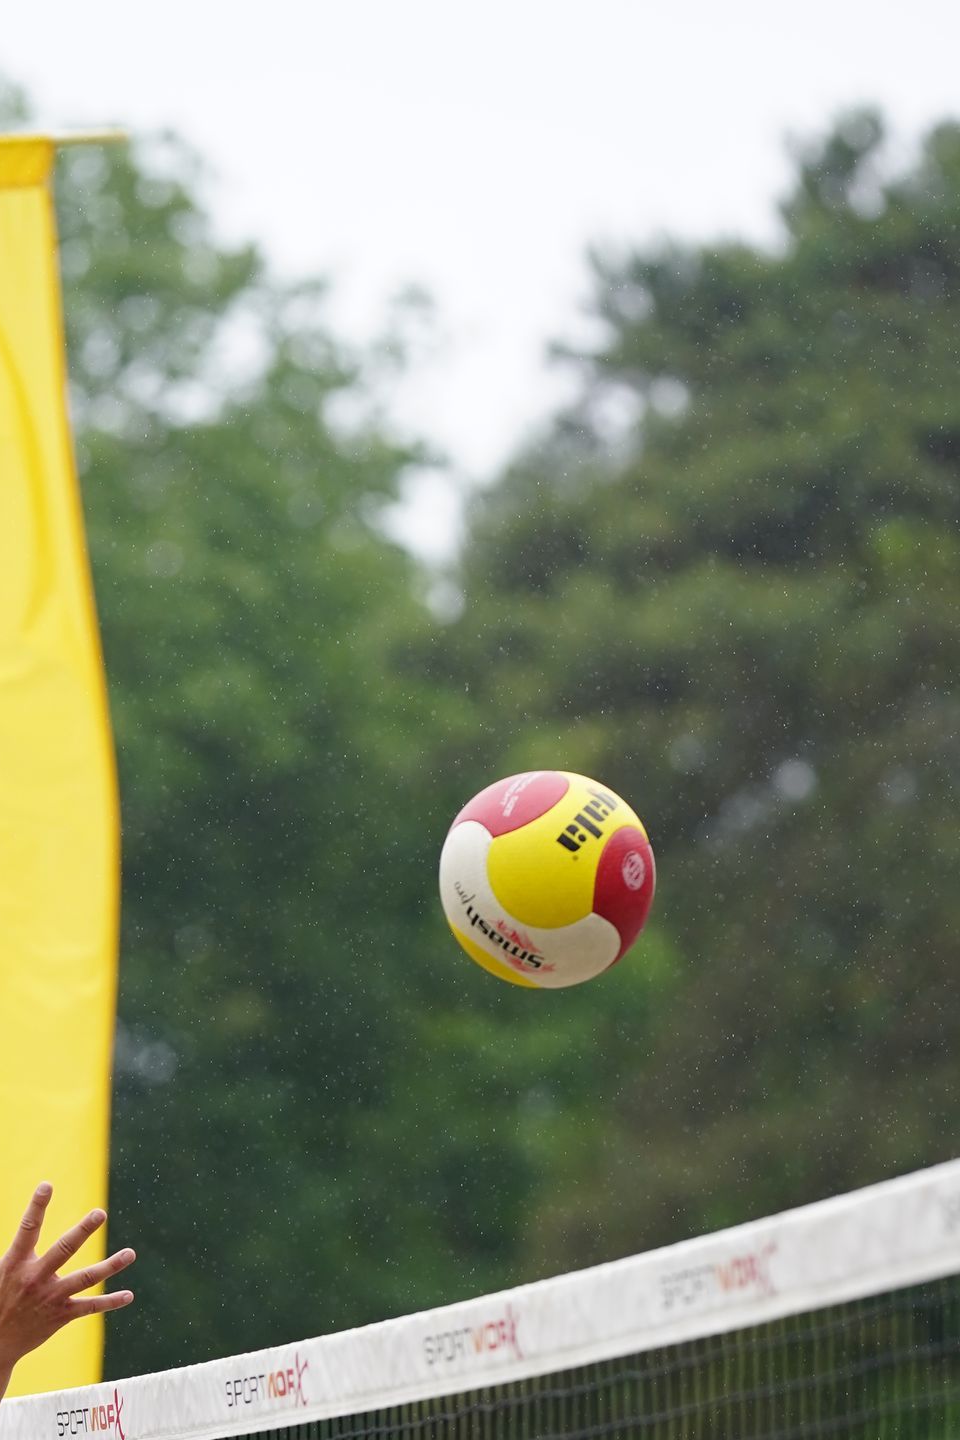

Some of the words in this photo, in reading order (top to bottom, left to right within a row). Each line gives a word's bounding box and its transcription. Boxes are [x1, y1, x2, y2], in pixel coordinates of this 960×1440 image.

[466, 906, 543, 969] smash
[225, 1352, 309, 1408] SPORTWORX
[56, 1388, 126, 1440] SPORTWORX
